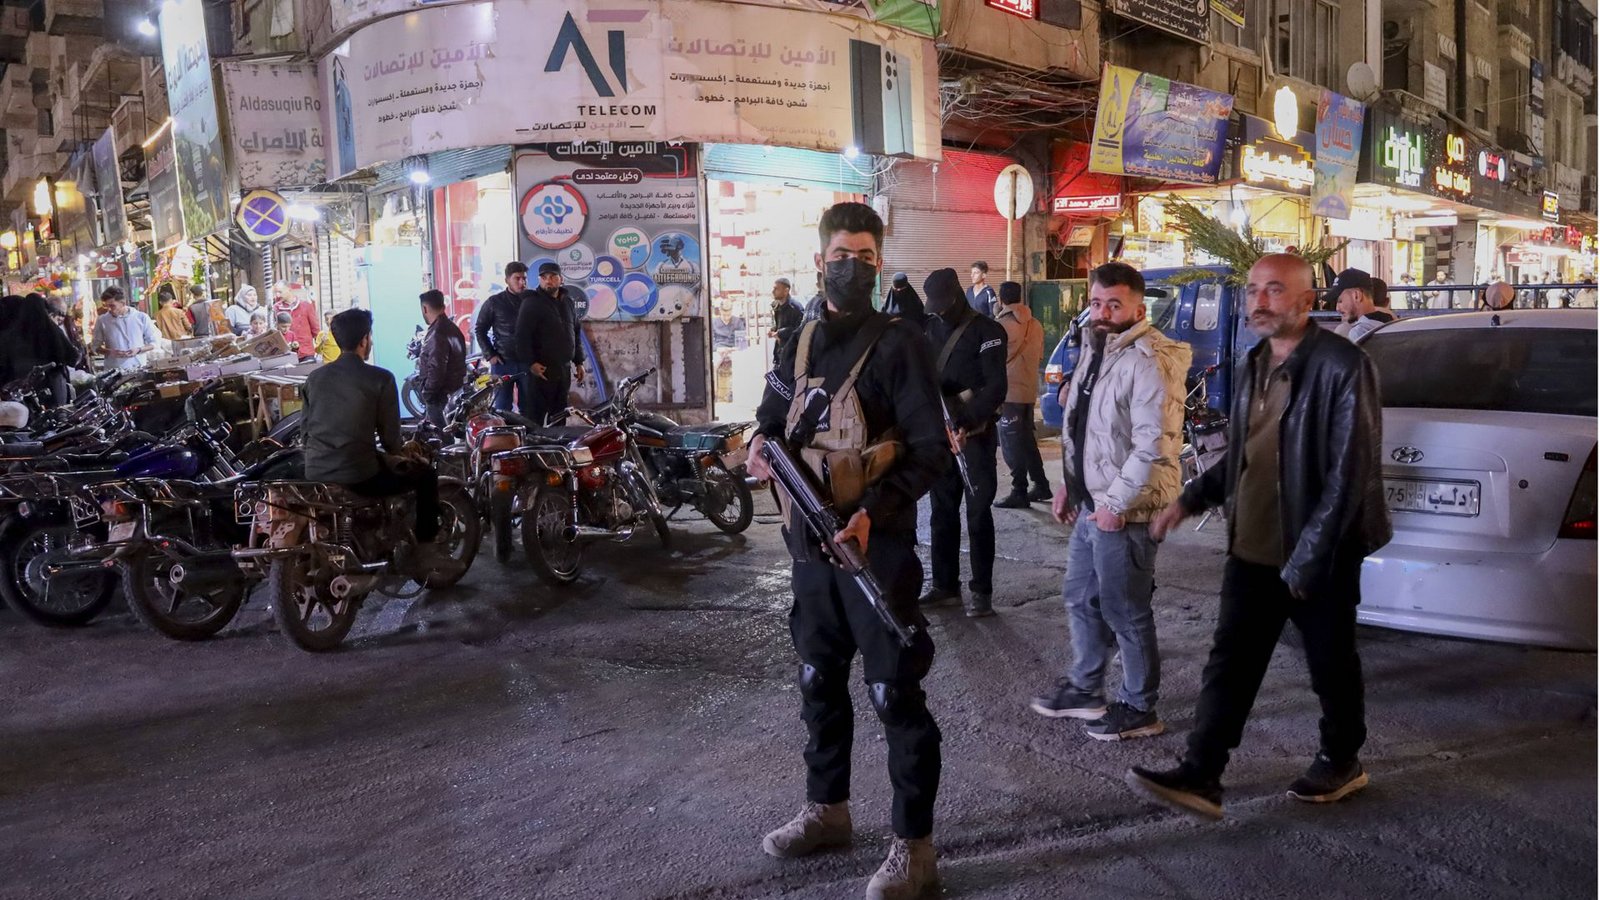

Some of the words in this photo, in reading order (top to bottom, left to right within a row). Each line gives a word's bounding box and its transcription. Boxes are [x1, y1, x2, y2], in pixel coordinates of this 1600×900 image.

[736, 75, 782, 88] ومستعملة
[784, 78, 806, 88] جديدة
[810, 80, 830, 91] أجهزة
[400, 86, 433, 98] ومستعملة
[435, 83, 457, 93] جديدة
[240, 96, 302, 114] Aldasuqiu
[734, 95, 763, 106] البرامج
[766, 95, 784, 106] كافة
[786, 98, 807, 108] شحن
[421, 105, 435, 113] كافة
[436, 101, 457, 113] شحن
[577, 105, 656, 116] TELECOM
[400, 109, 420, 122] البرامج
[576, 171, 593, 180] لدى
[594, 172, 618, 181] معتمد
[620, 171, 639, 181] وكيل
[1089, 196, 1114, 209] الدكتور
[1387, 487, 1404, 502] 75
